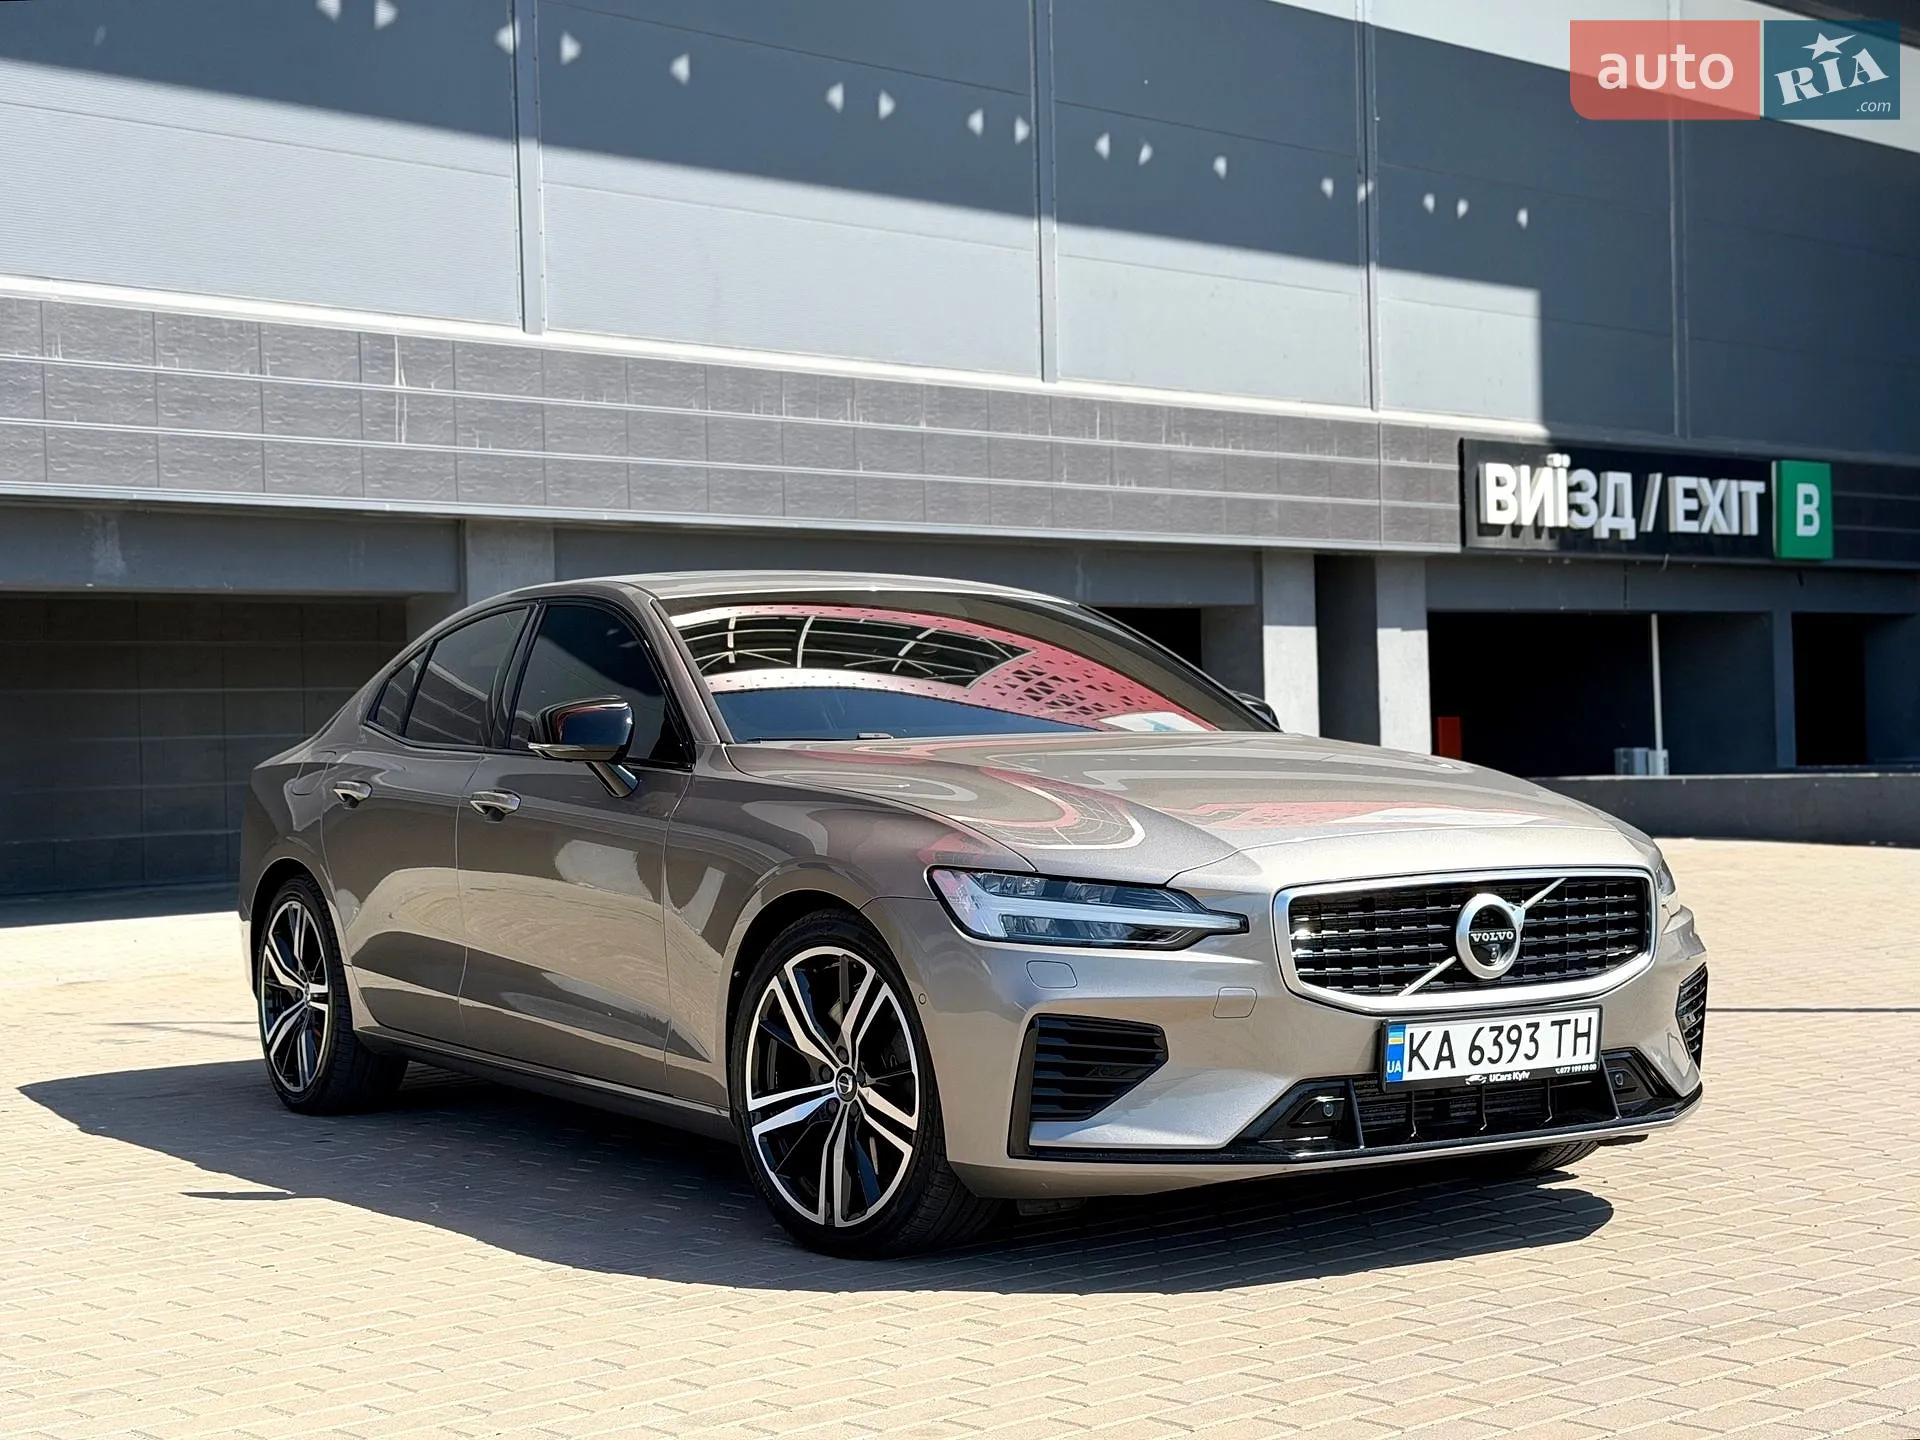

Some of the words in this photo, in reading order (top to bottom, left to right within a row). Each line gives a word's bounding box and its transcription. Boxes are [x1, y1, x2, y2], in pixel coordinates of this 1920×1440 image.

[1480, 452, 1637, 540] ВИЇЗД
[1640, 472, 1663, 533] /
[1668, 475, 1766, 536] EXIT
[1470, 931, 1514, 942] VOLVO
[1407, 1029, 1456, 1072] KA
[1468, 1021, 1540, 1066] 6393
[1550, 1016, 1593, 1059] TH
[1386, 1060, 1402, 1074] UA
